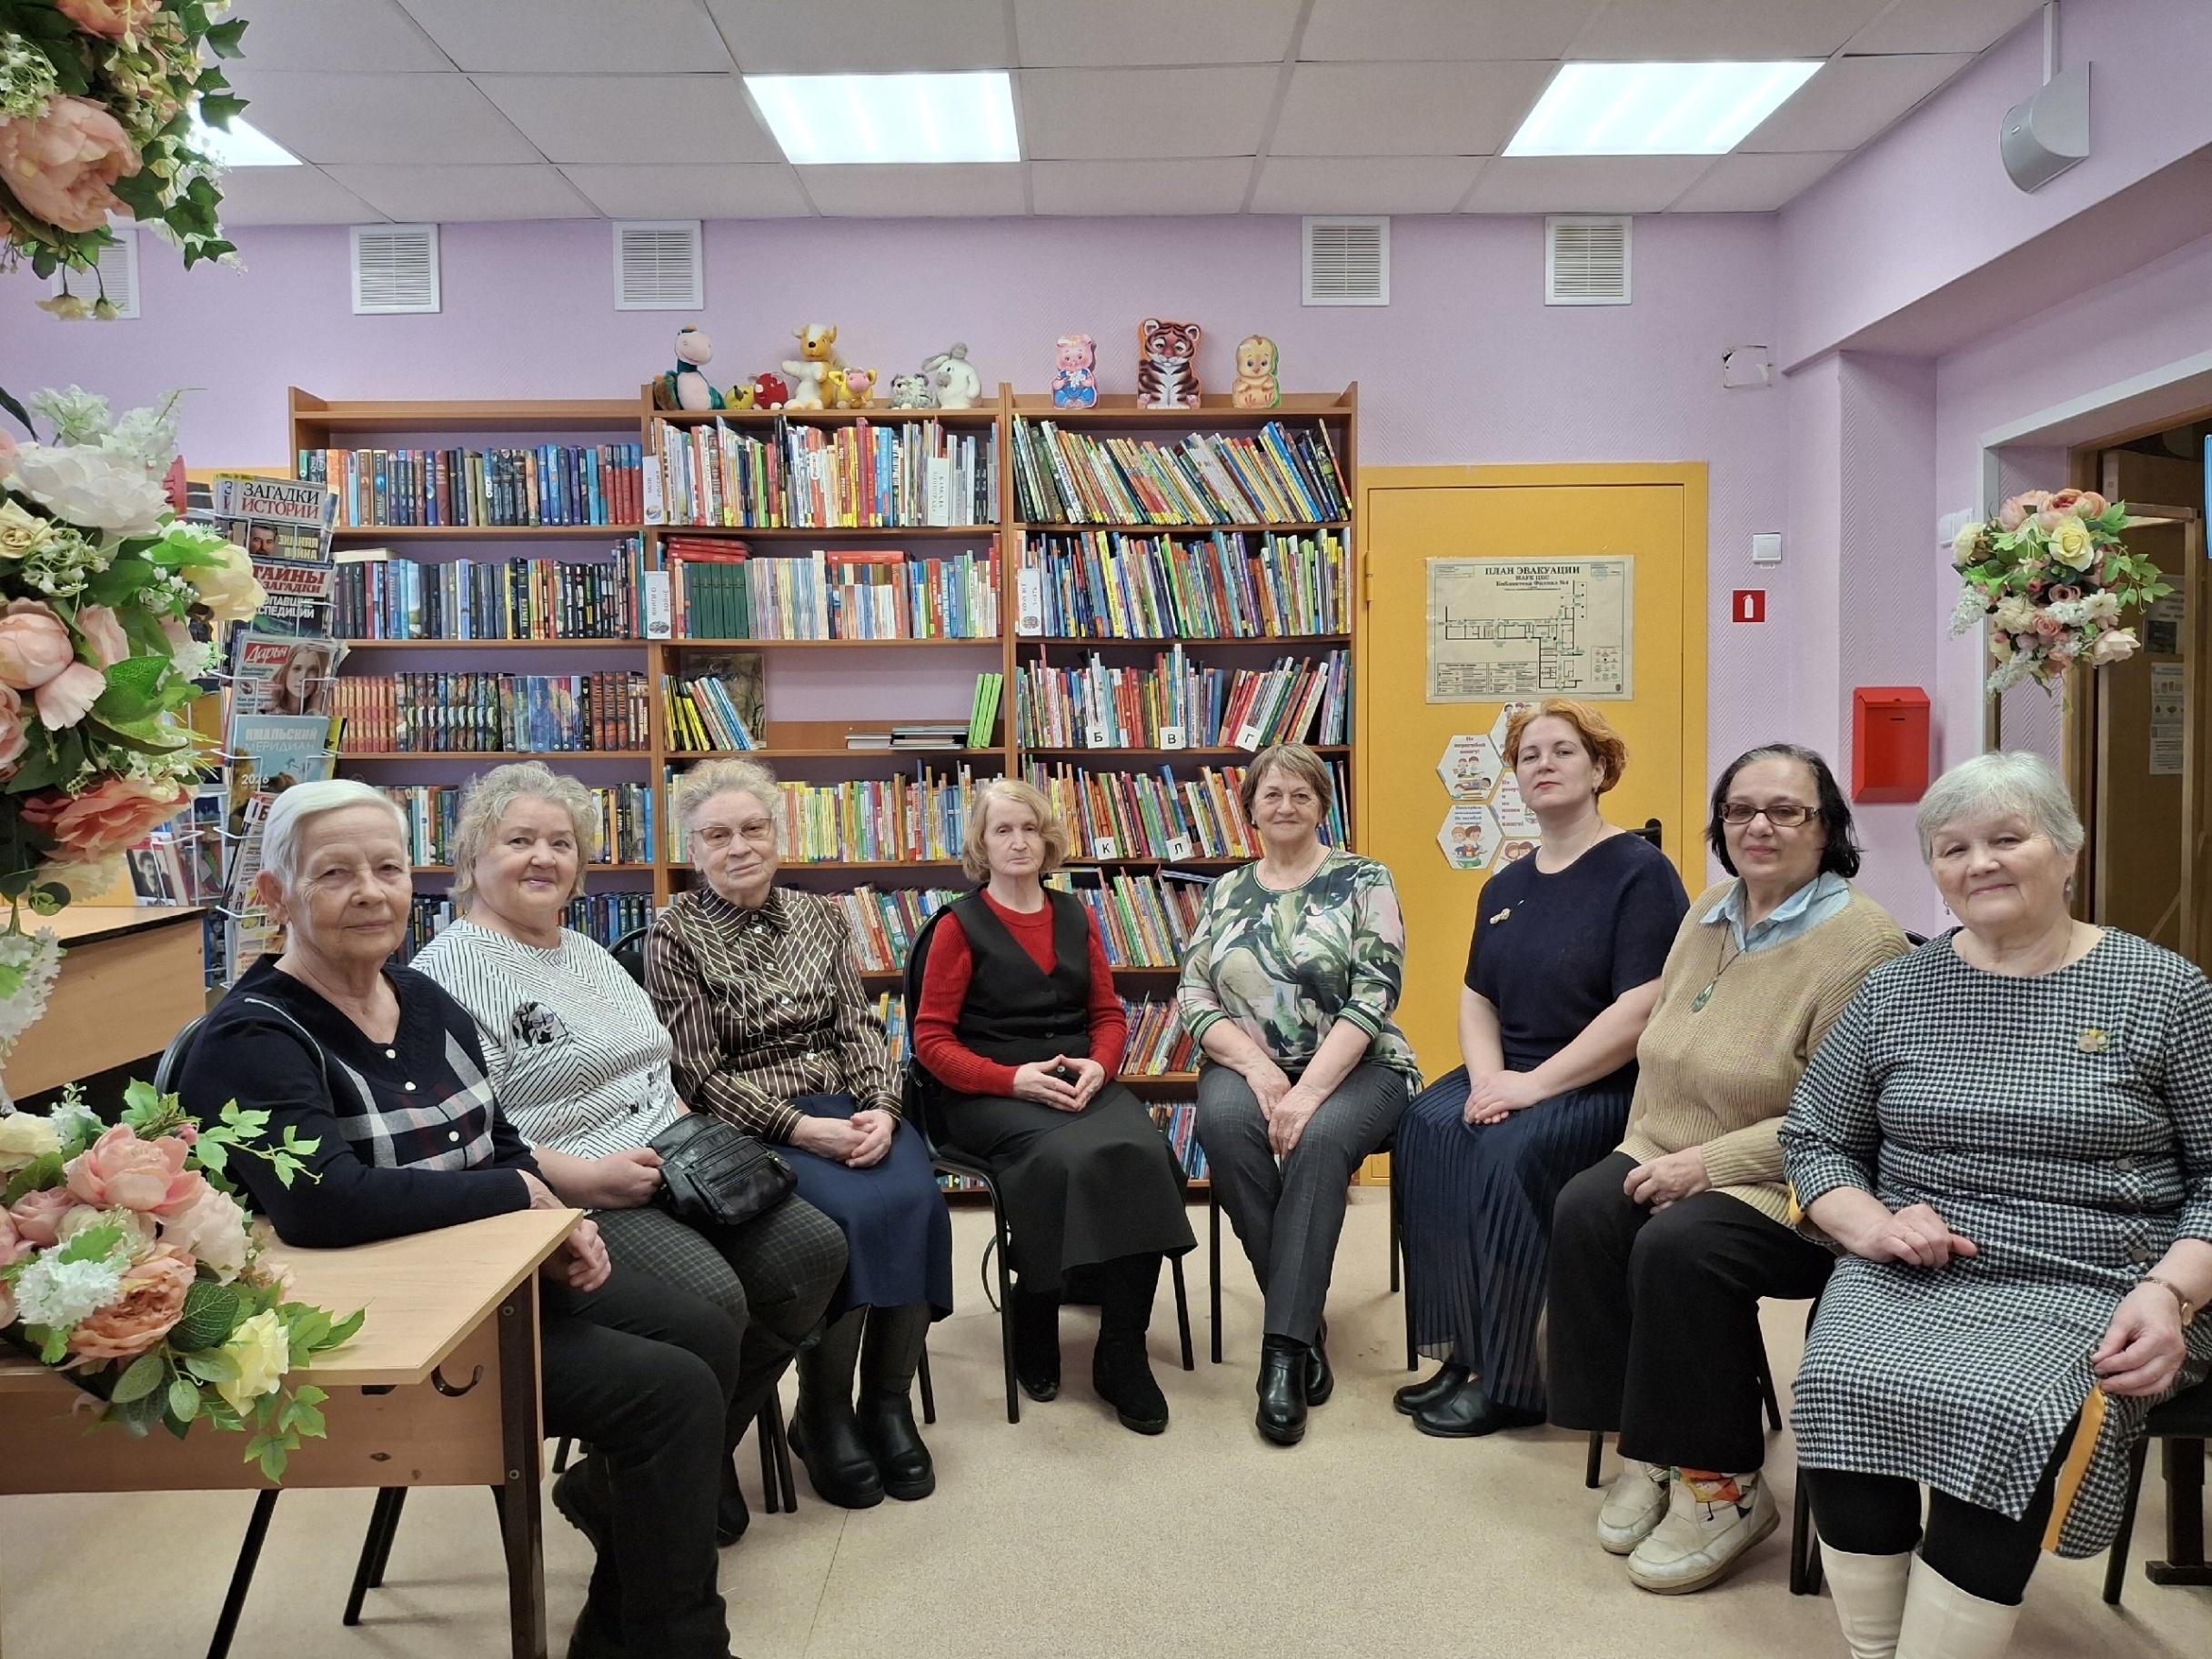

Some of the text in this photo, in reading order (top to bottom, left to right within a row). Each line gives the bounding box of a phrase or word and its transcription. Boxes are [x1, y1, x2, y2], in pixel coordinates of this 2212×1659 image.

[244, 482, 319, 505] ЗАГАДКИ
[242, 497, 318, 519] ИСТОРИИ
[1485, 566, 1581, 576] ПЛАН ЭВАКУАЦИИ
[262, 580, 321, 594] ЗАГАДКИ
[244, 644, 288, 666] Дарья
[245, 727, 318, 741] ЯМАЛЬСКИЙ
[1092, 730, 1103, 743] Б
[1166, 734, 1177, 745] В
[1243, 733, 1253, 744] Г
[1101, 842, 1111, 854] К
[1174, 842, 1184, 855] Л
